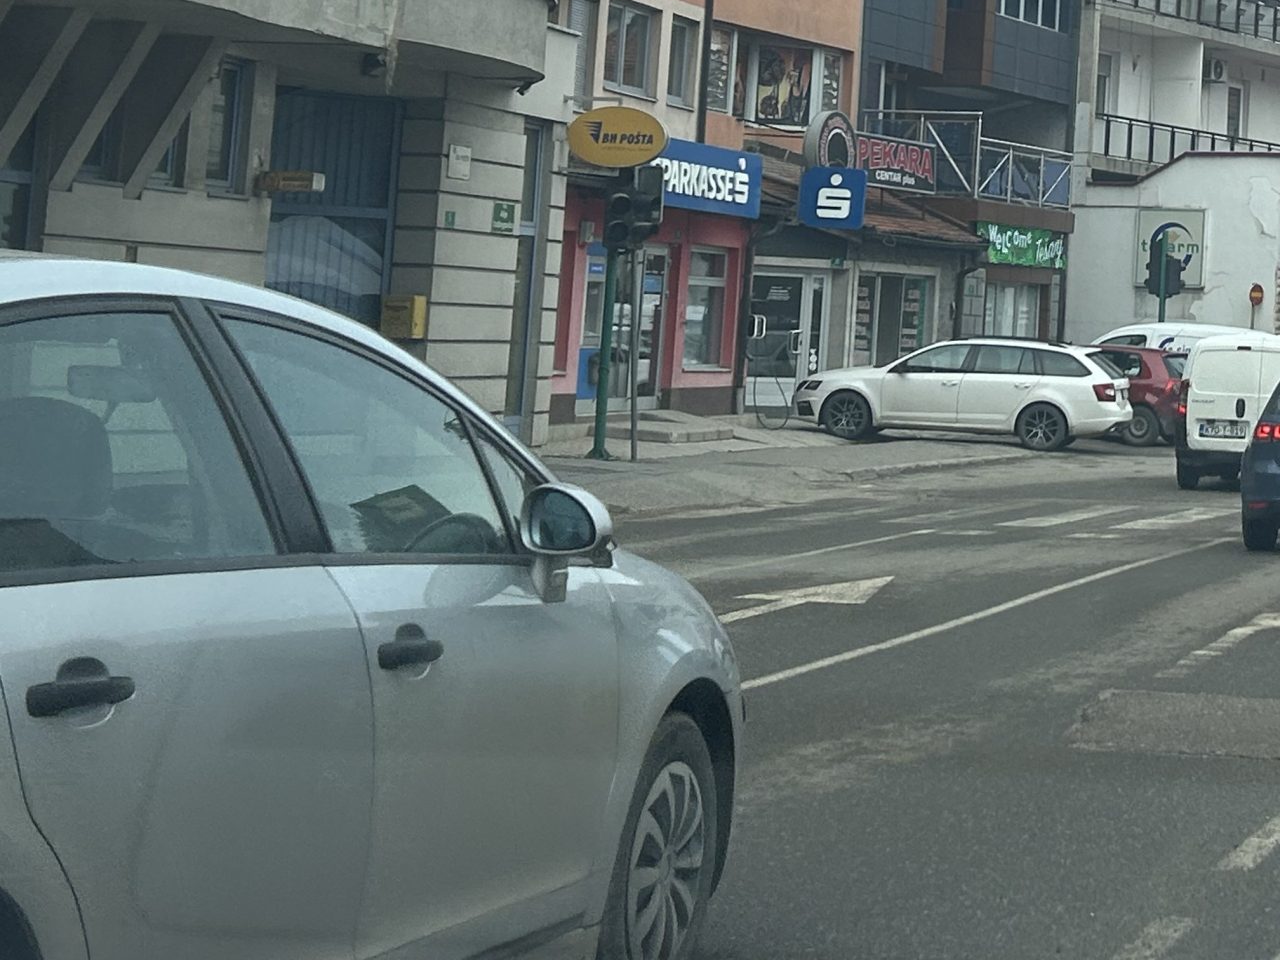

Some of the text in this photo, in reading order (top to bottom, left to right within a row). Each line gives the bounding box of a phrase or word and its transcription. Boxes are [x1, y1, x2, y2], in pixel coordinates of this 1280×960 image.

[602, 131, 653, 144] BH POŠTA
[856, 136, 934, 184] PEKARA
[875, 169, 915, 186] CENTAR plus
